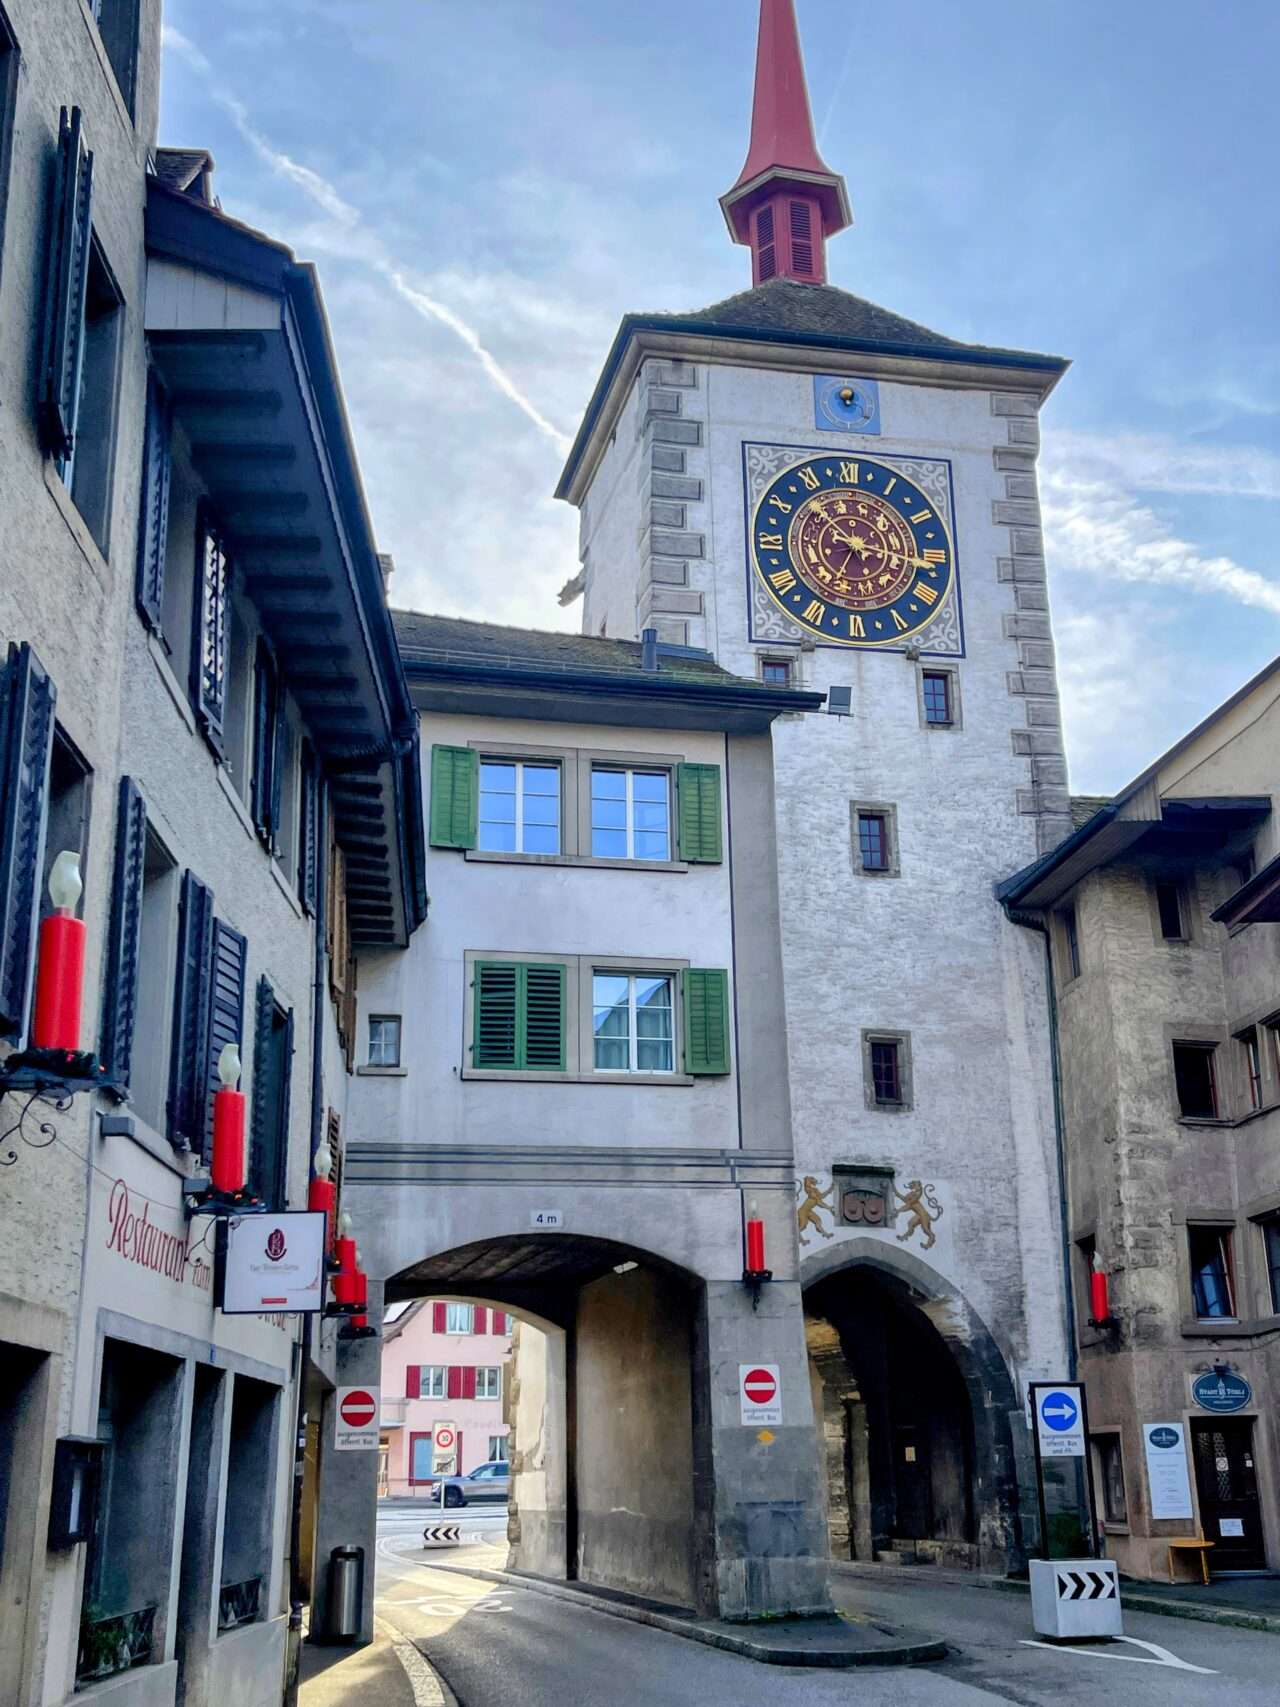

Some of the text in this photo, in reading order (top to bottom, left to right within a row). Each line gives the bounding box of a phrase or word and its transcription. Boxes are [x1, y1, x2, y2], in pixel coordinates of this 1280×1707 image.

[798, 466, 821, 490] XI
[840, 461, 859, 484] XII
[884, 478, 896, 495] I
[769, 494, 792, 513] X
[910, 509, 932, 524] II
[759, 531, 783, 550] IX
[923, 548, 946, 563] III
[768, 569, 797, 596] VIII
[913, 581, 938, 606] IIII
[801, 600, 826, 626] VII
[890, 609, 909, 631] V
[849, 614, 866, 638] VI
[536, 1213, 557, 1224] 4 m
[106, 1179, 188, 1283] Restaurant
